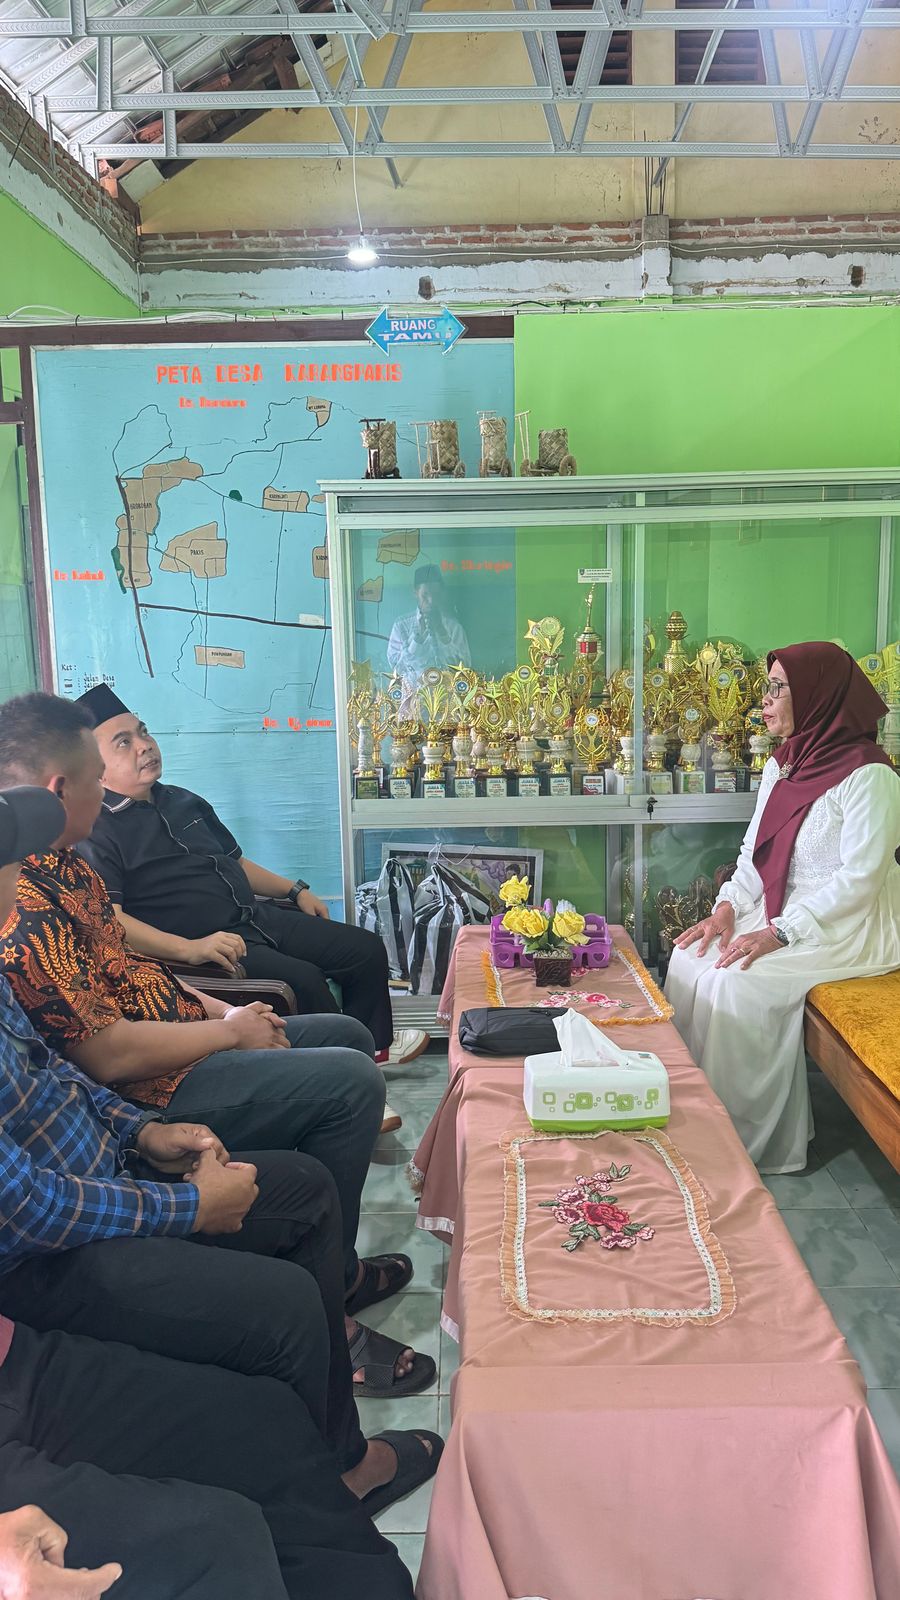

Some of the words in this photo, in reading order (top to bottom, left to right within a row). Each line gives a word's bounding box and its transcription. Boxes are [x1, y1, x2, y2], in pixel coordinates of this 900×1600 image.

[390, 319, 436, 332] RUANG
[378, 332, 453, 341] TAMU
[156, 364, 203, 384] PETA
[215, 363, 263, 383] DESA
[284, 363, 402, 382] KARANGPAKIS
